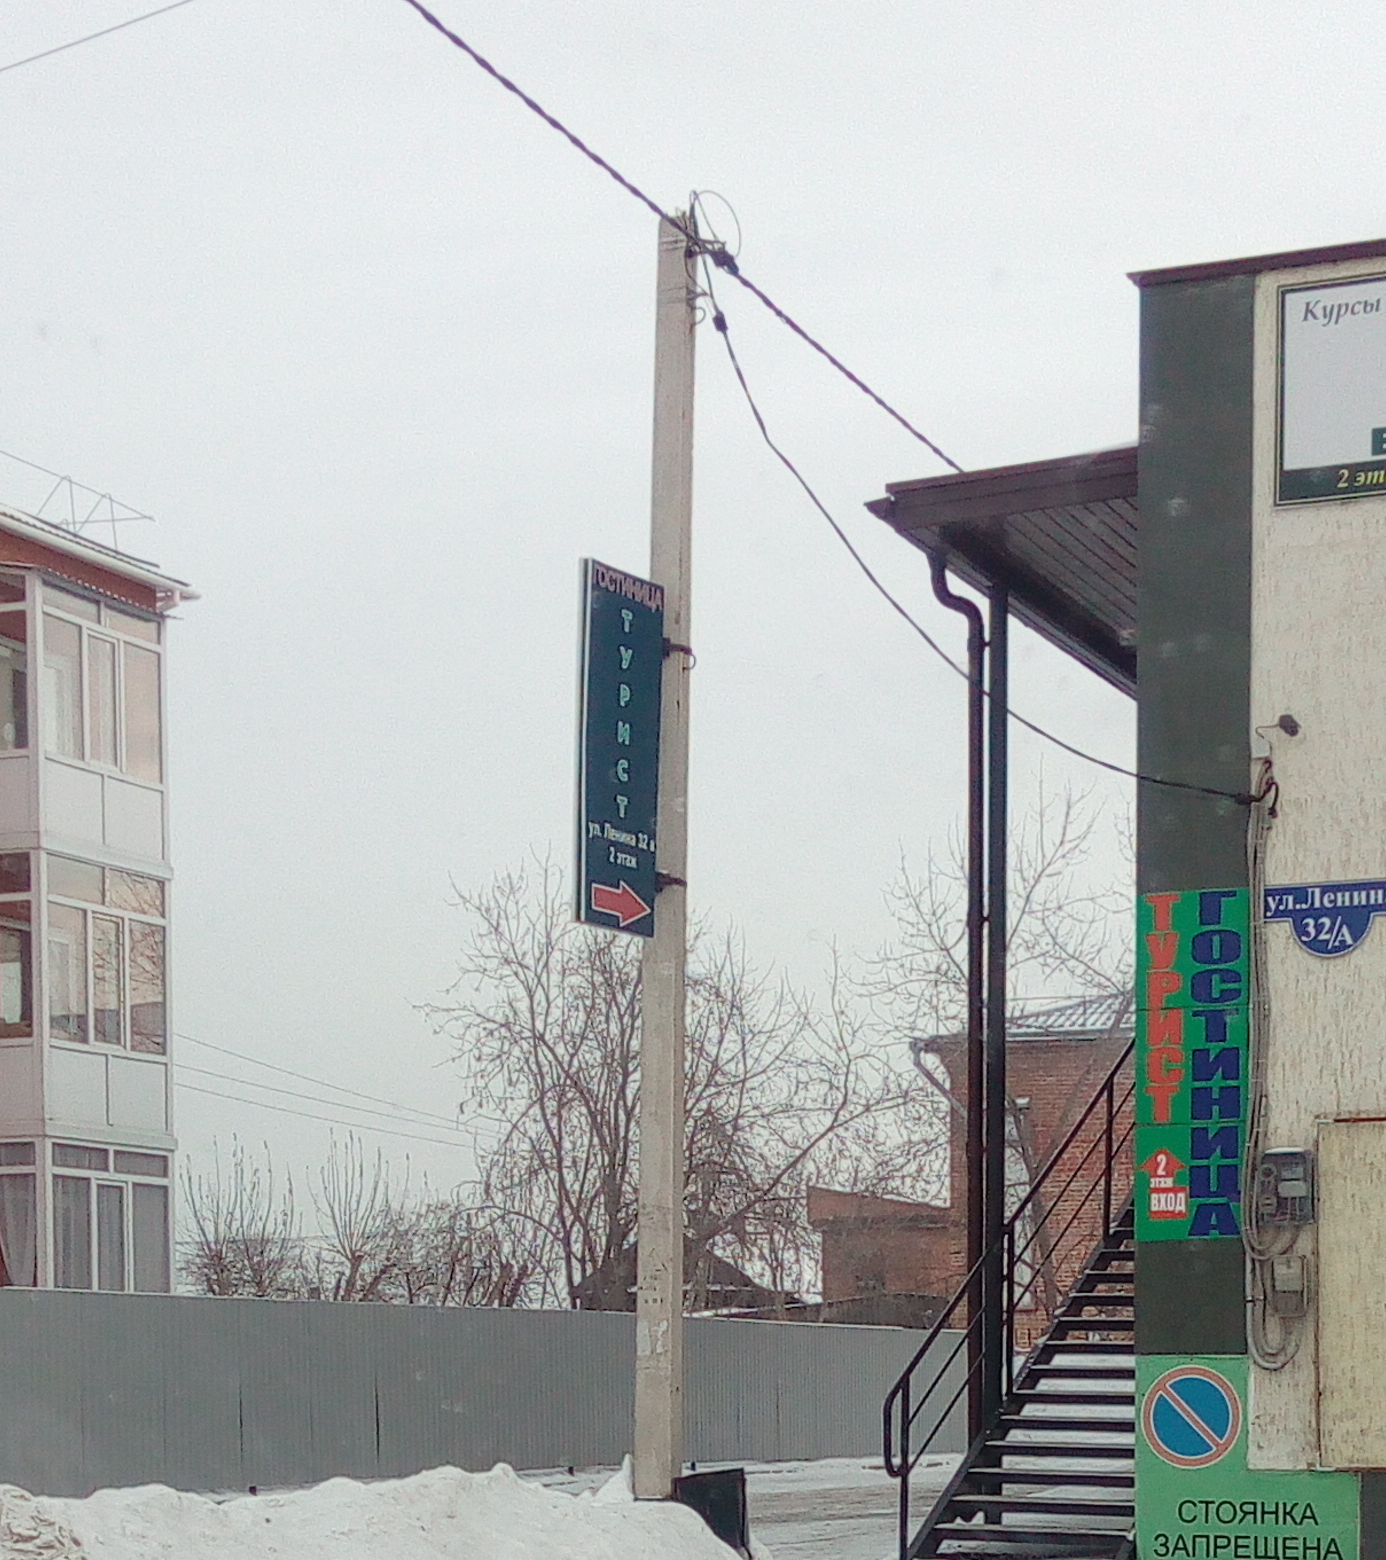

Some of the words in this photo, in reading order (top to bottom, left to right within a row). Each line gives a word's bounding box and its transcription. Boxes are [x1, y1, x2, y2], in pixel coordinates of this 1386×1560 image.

[1302, 299, 1380, 327] Курсы
[1337, 470, 1349, 489] 2
[593, 562, 663, 613] ГОСТИНИЦА
[615, 608, 633, 819] ТУРИСТ
[1144, 893, 1185, 1123] ТУРИСТ
[1187, 890, 1244, 1237] ГОСТИНИЦА
[1156, 1154, 1167, 1176] 2
[1150, 1192, 1186, 1213] ВХОД
[1177, 1500, 1320, 1526] СТОЯНКА
